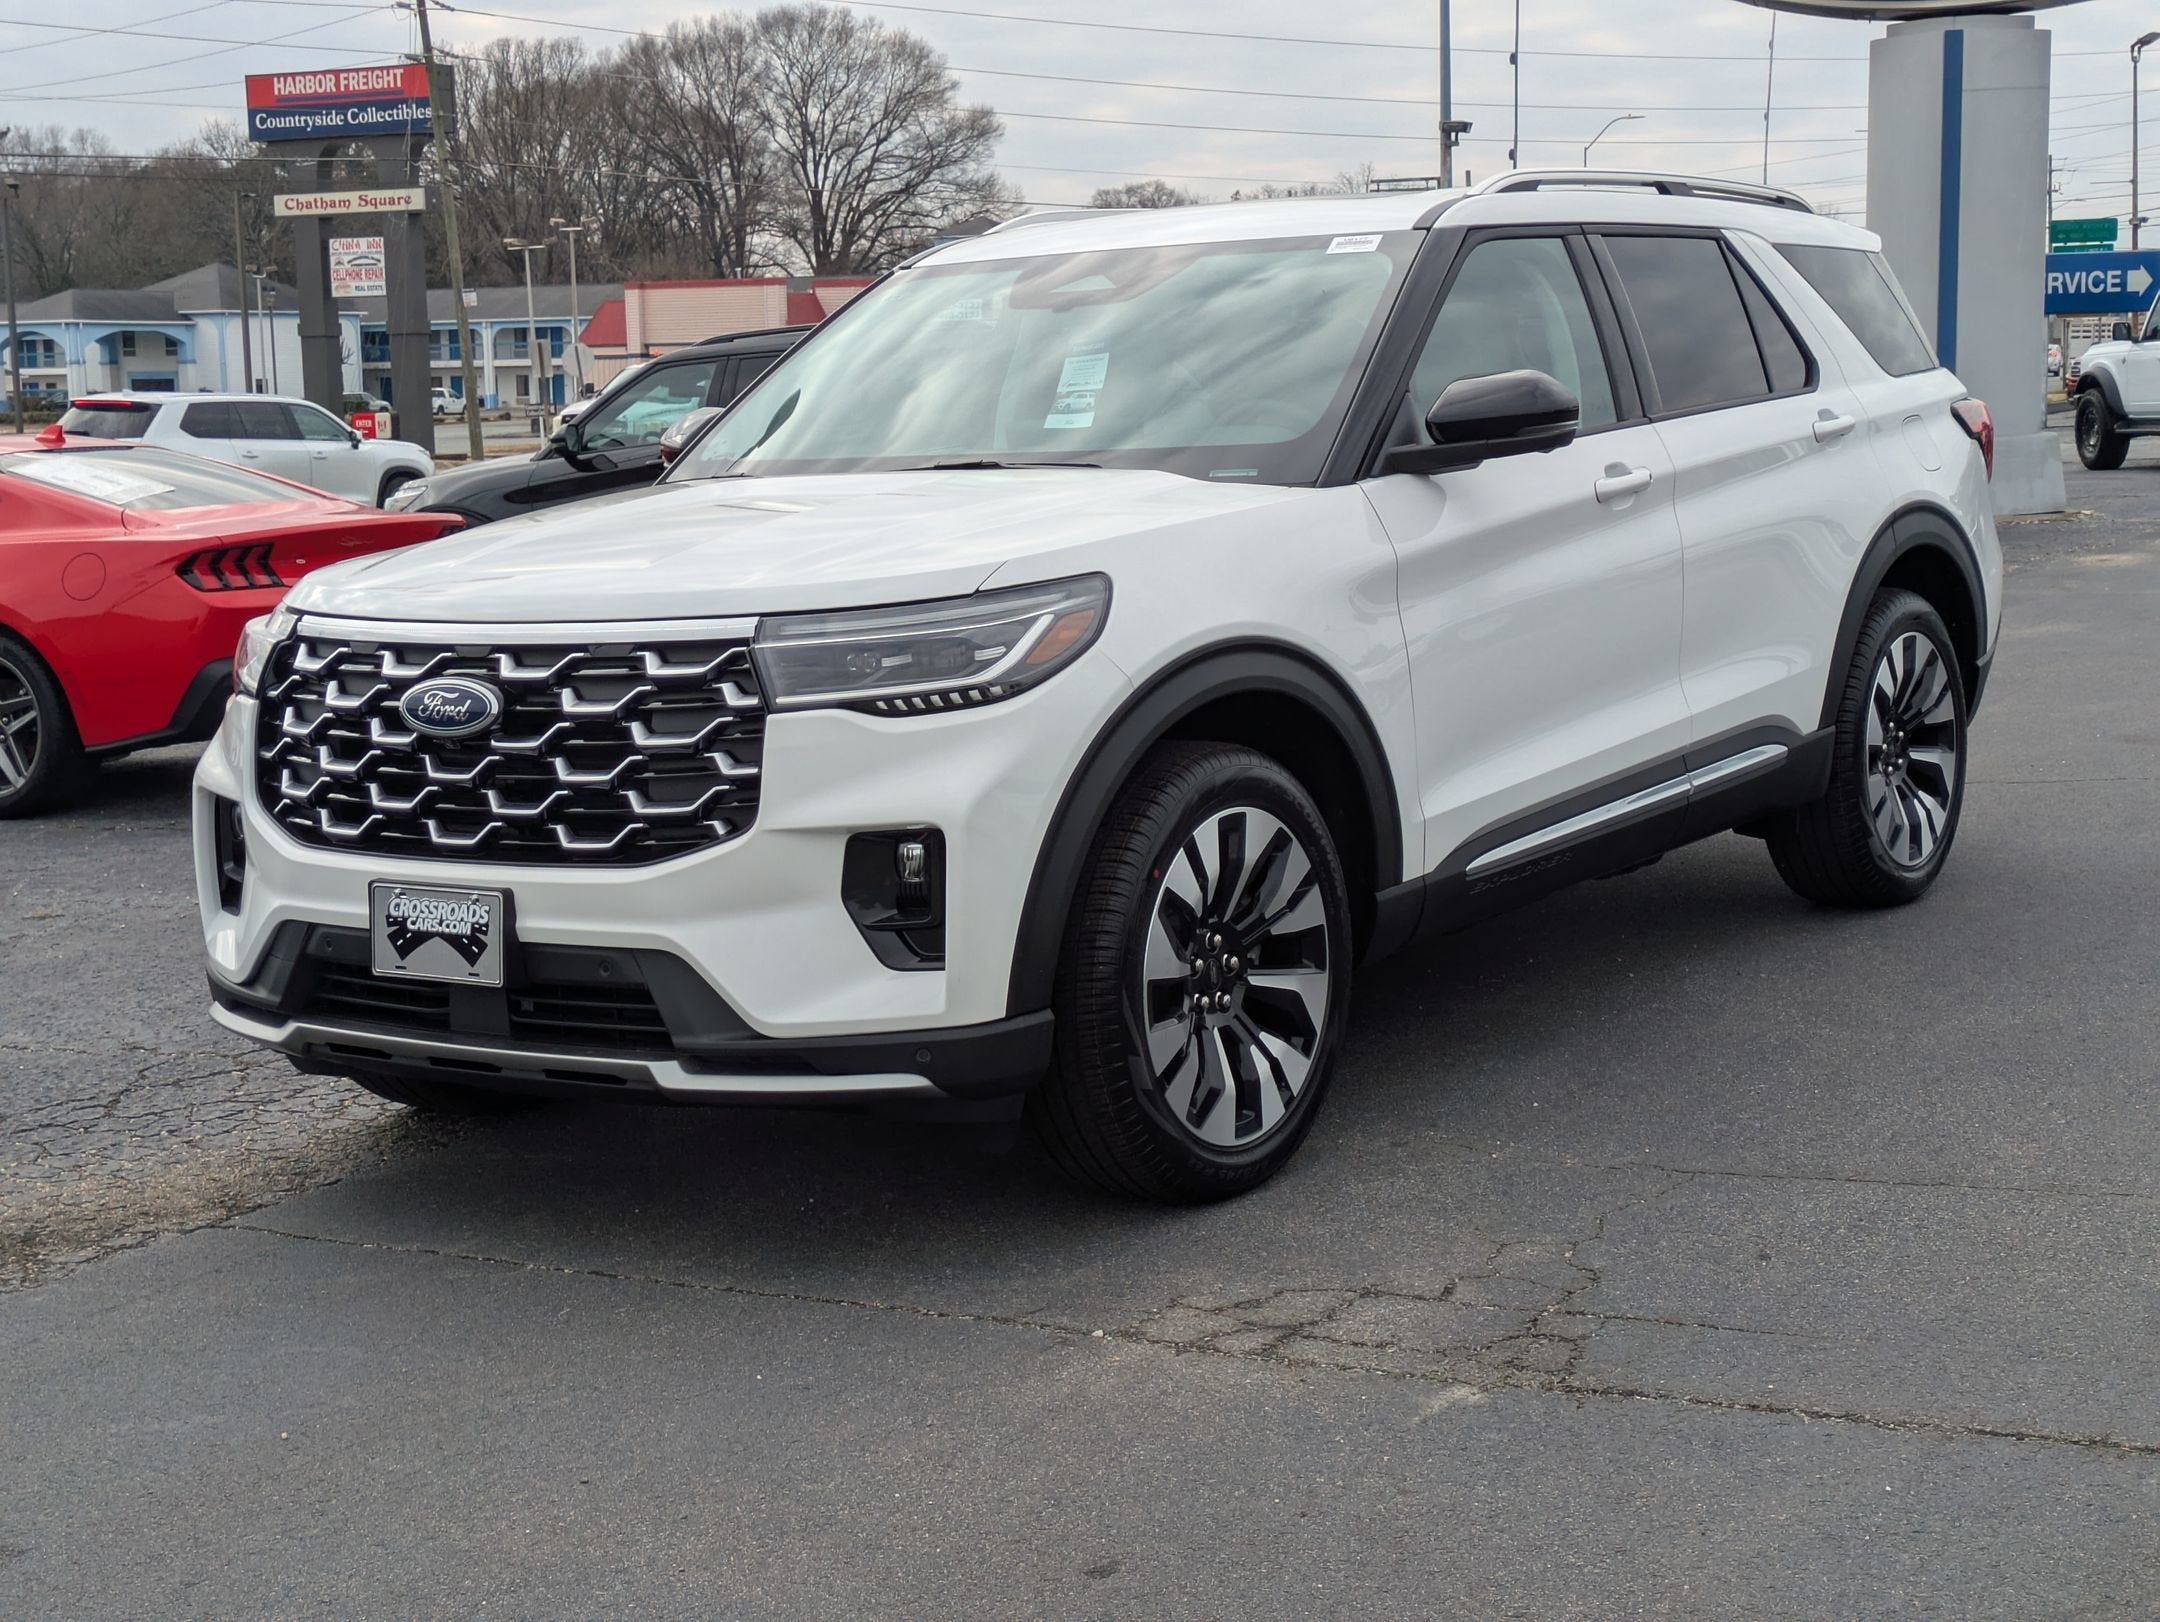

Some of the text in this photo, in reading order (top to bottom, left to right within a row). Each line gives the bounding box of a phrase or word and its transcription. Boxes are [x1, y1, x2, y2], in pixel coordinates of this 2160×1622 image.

[273, 68, 404, 96] HARBOR FREIGHT
[255, 104, 432, 132] Countryside Collectibles
[284, 194, 413, 212] Chatham Square
[333, 268, 384, 281] CELLPHONE REPAIR
[417, 690, 472, 721] Ford
[388, 897, 490, 924] CROSSROADS
[406, 916, 473, 936] CARS.COM
